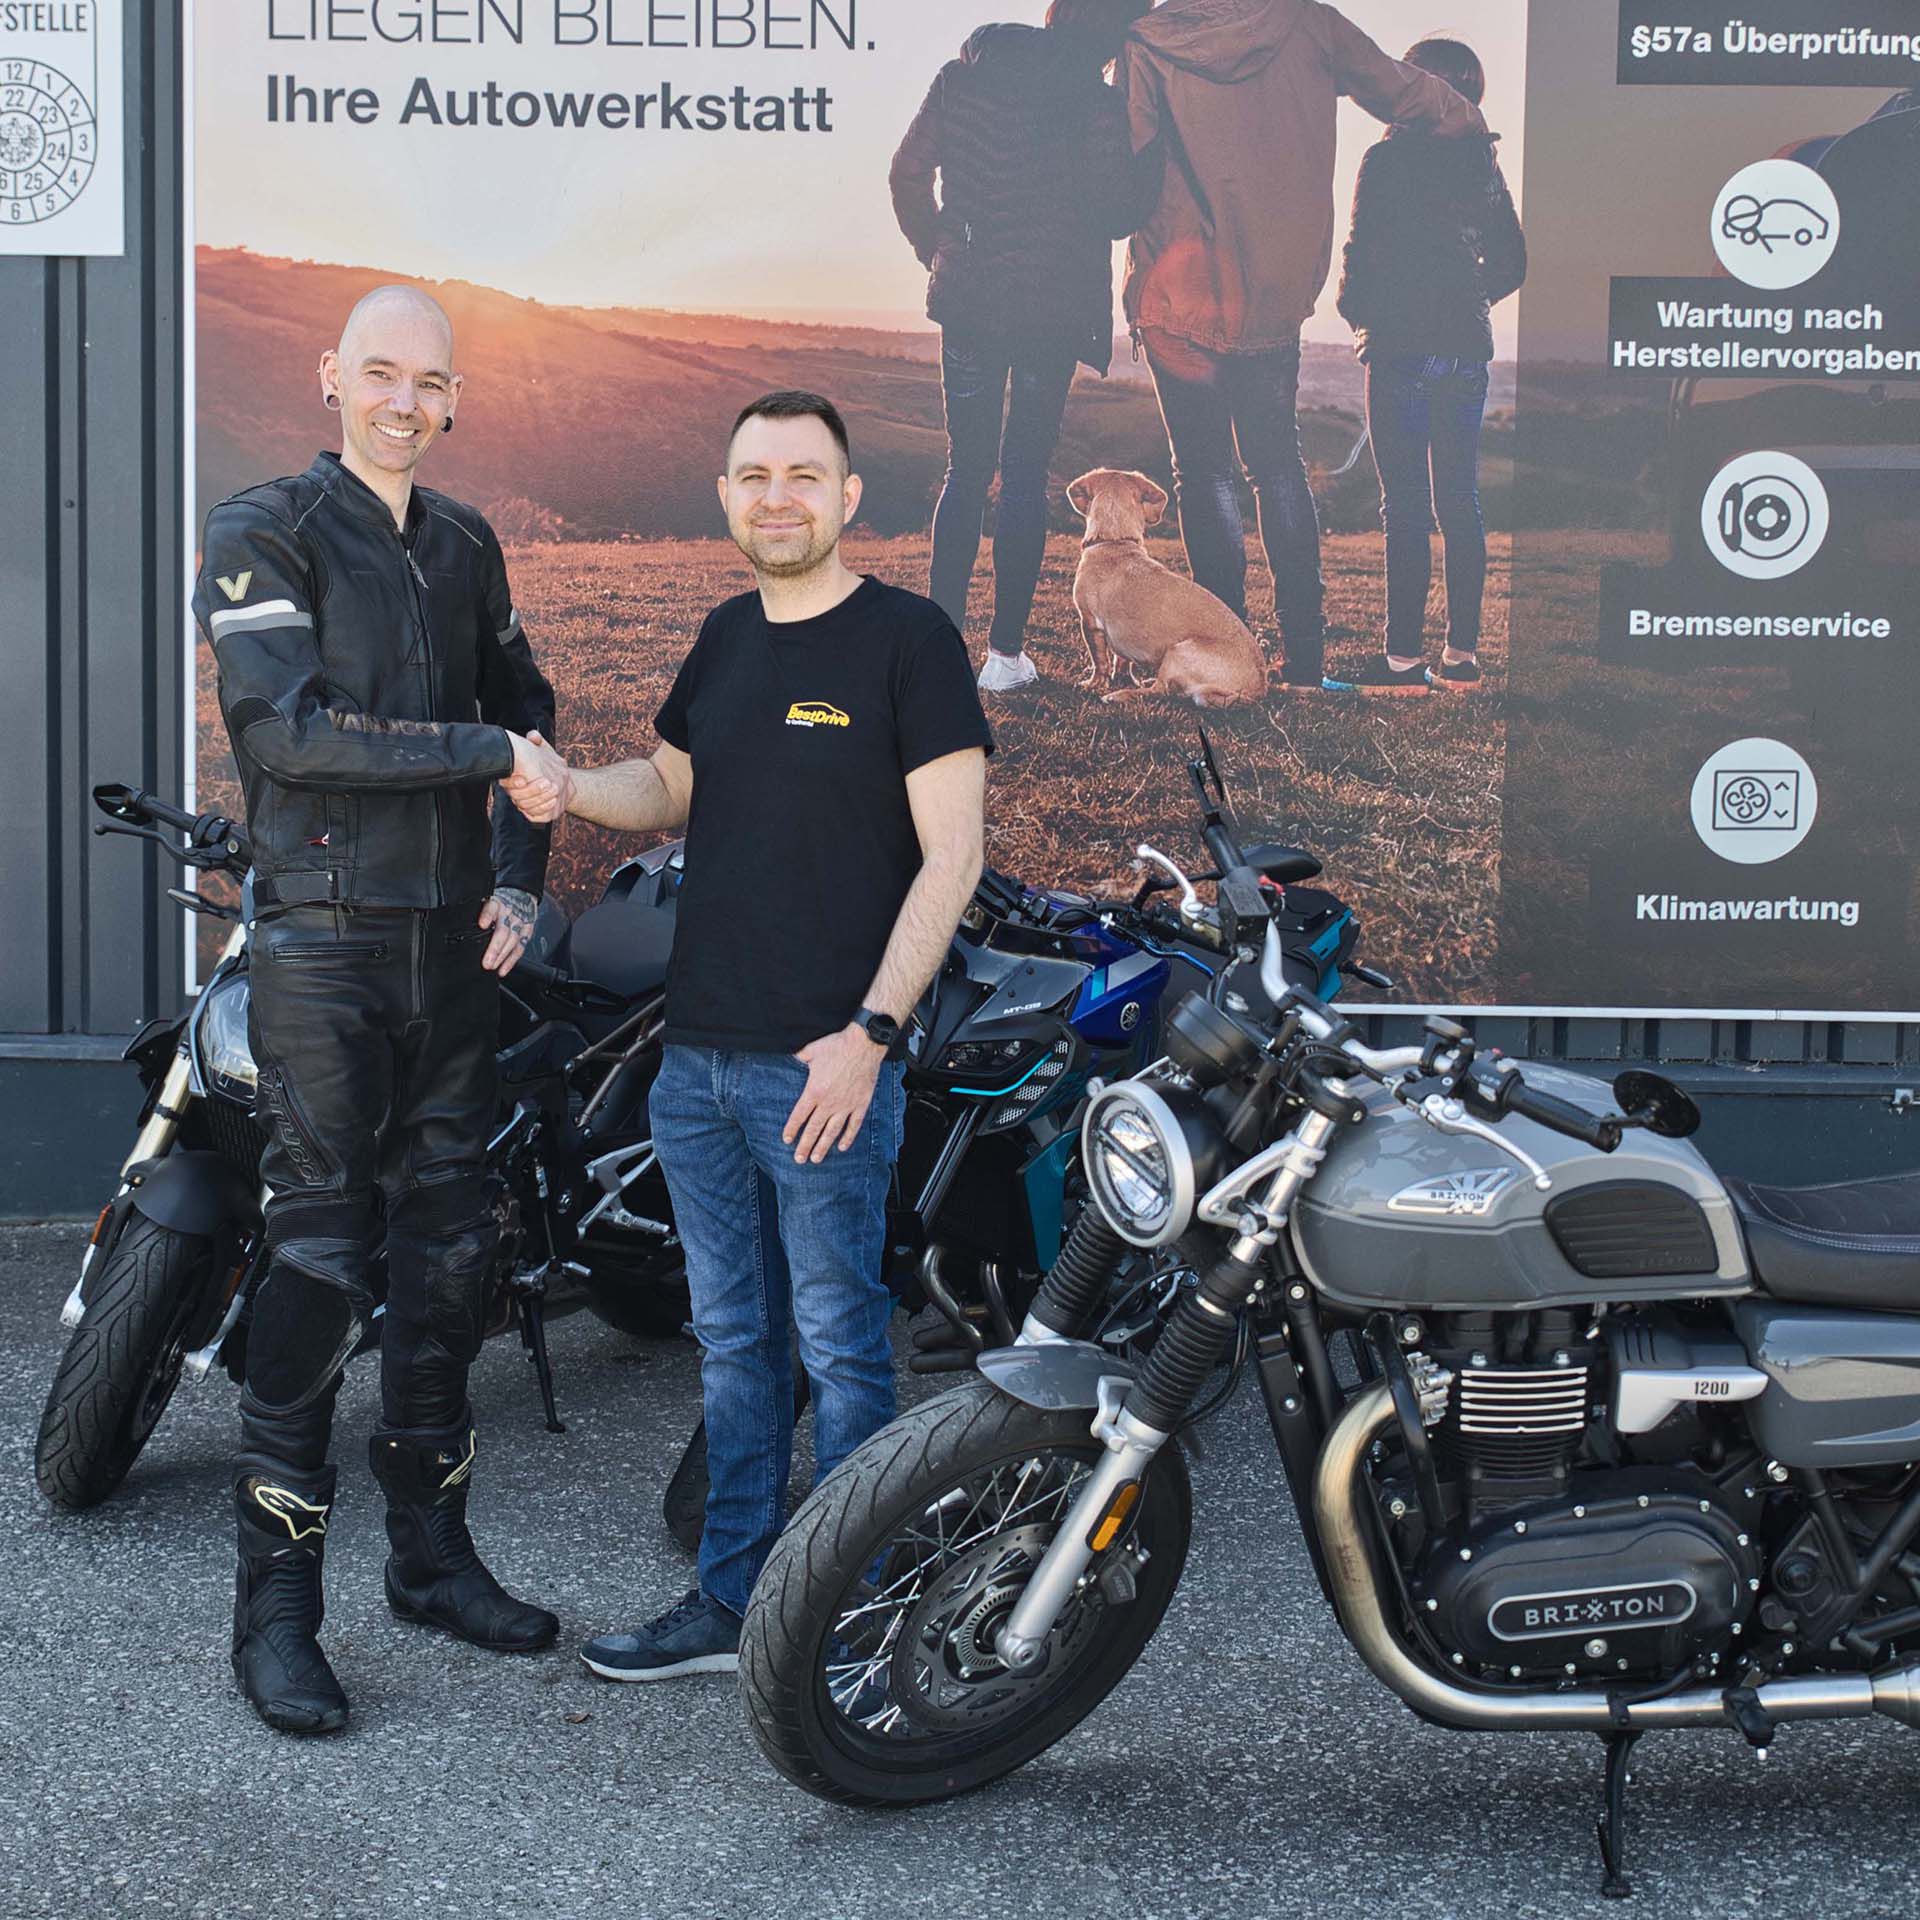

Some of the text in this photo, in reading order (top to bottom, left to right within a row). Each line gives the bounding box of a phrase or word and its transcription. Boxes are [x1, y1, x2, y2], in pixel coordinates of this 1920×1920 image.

[0, 3, 88, 32] STELLE
[268, 0, 876, 51] LIEGEN BLEIBEN.
[1631, 24, 1712, 58] §57a
[6, 62, 23, 81] 12
[5, 88, 25, 108] 22
[69, 98, 80, 118] 2
[267, 74, 833, 133] Ihre Autowerkstatt
[39, 105, 59, 125] 23
[47, 142, 66, 161] 24
[79, 133, 89, 152] 3
[24, 172, 43, 191] 25
[69, 168, 79, 187] 4
[11, 202, 21, 221] 6
[46, 193, 55, 212] 5
[1657, 301, 1883, 334] Wartung nach
[1613, 340, 1920, 375] Herstellervorgaben
[1629, 609, 1891, 638] Bremsenservice
[787, 704, 850, 727] BestDrive
[1636, 894, 1859, 926] Klimawartung
[1430, 1191, 1485, 1201] BRIXTON
[1694, 1381, 1729, 1396] 1200
[1524, 1595, 1664, 1627] BRIXTON
